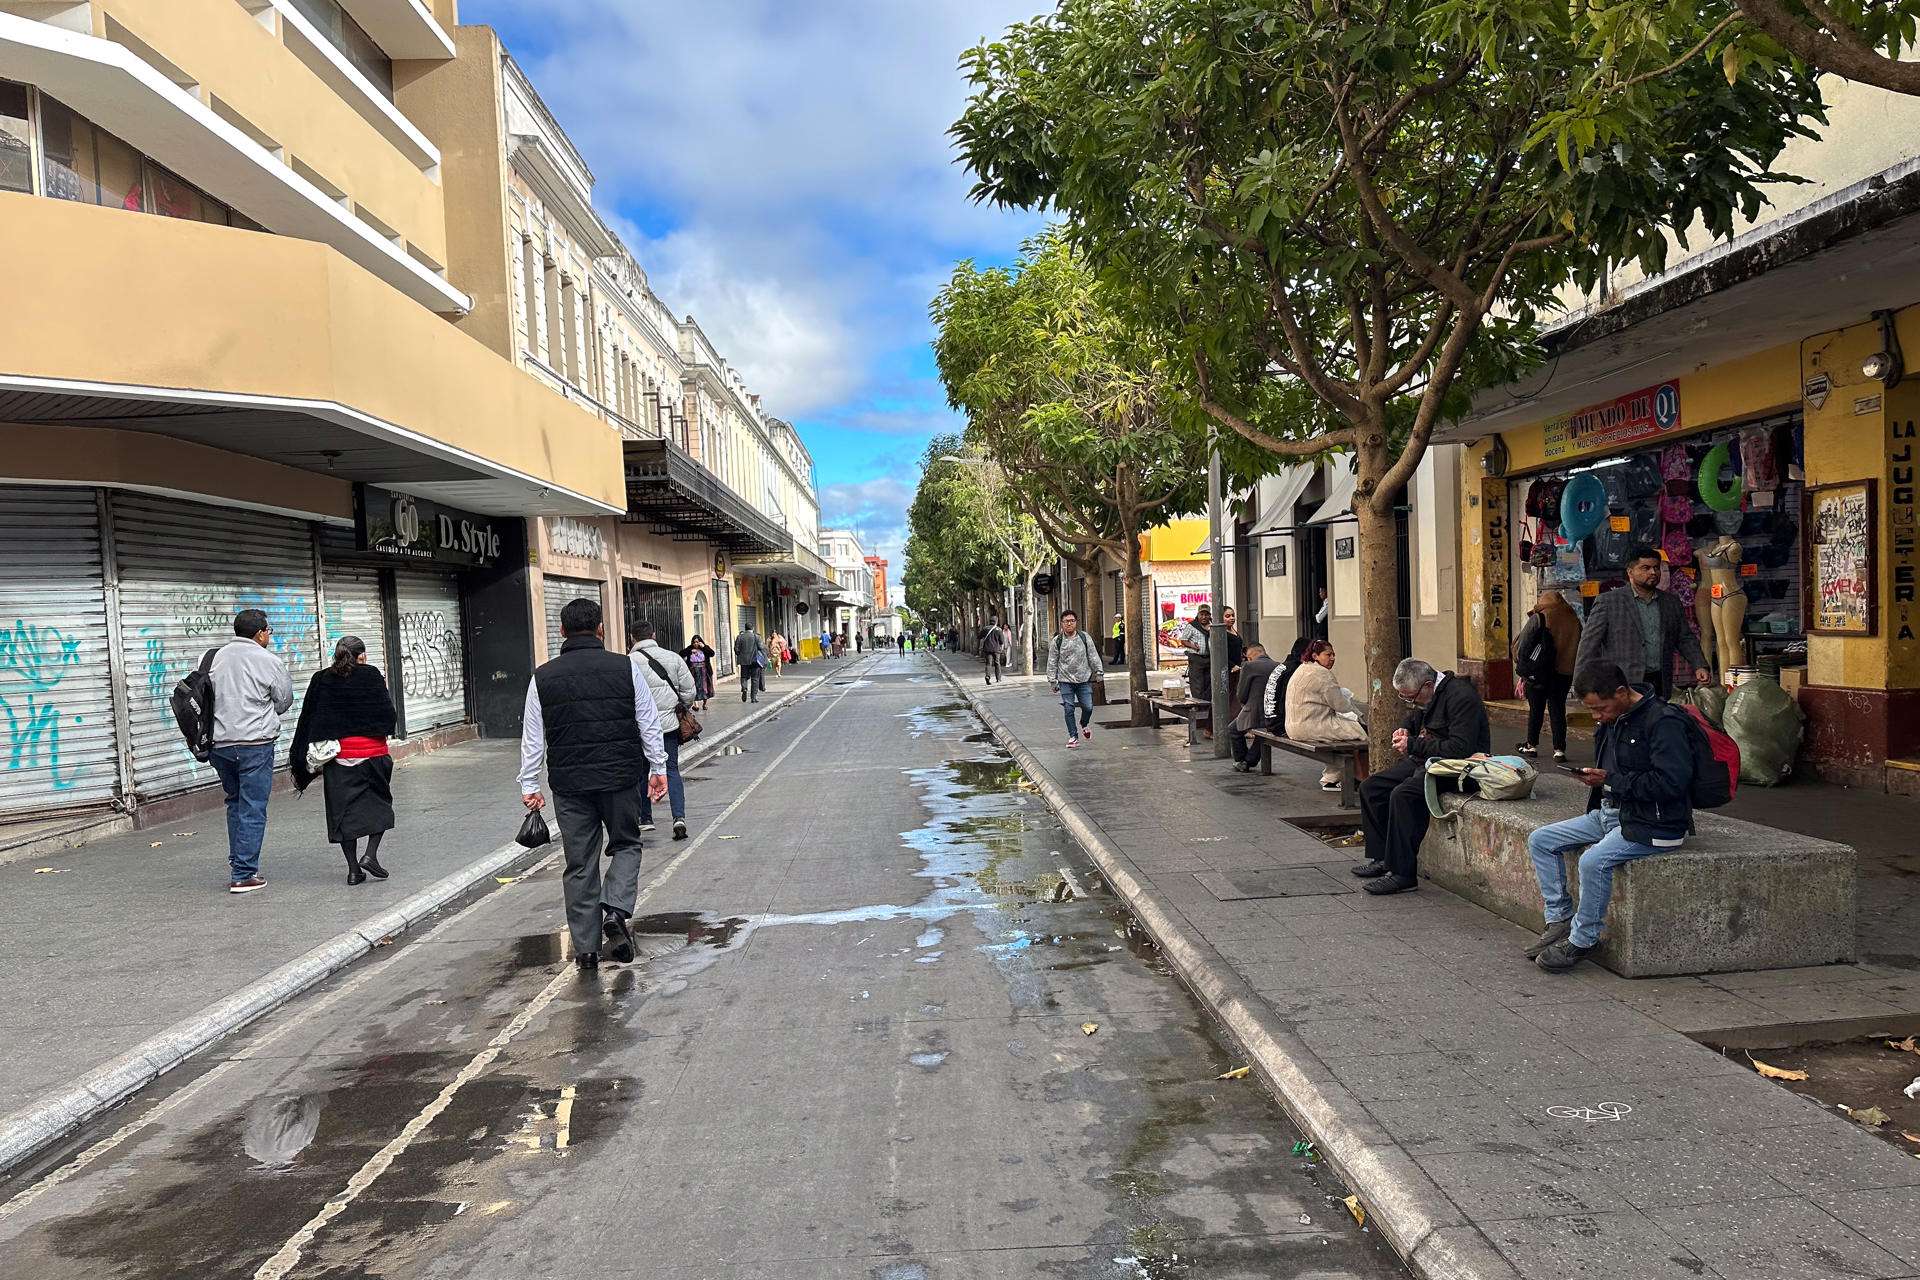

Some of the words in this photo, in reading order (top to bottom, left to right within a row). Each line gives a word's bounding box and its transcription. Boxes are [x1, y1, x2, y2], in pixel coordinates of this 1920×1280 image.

[1579, 402, 1626, 434] MUNDO
[1631, 397, 1651, 421] DE
[1656, 391, 1677, 423] Q1
[1892, 420, 1916, 439] LA
